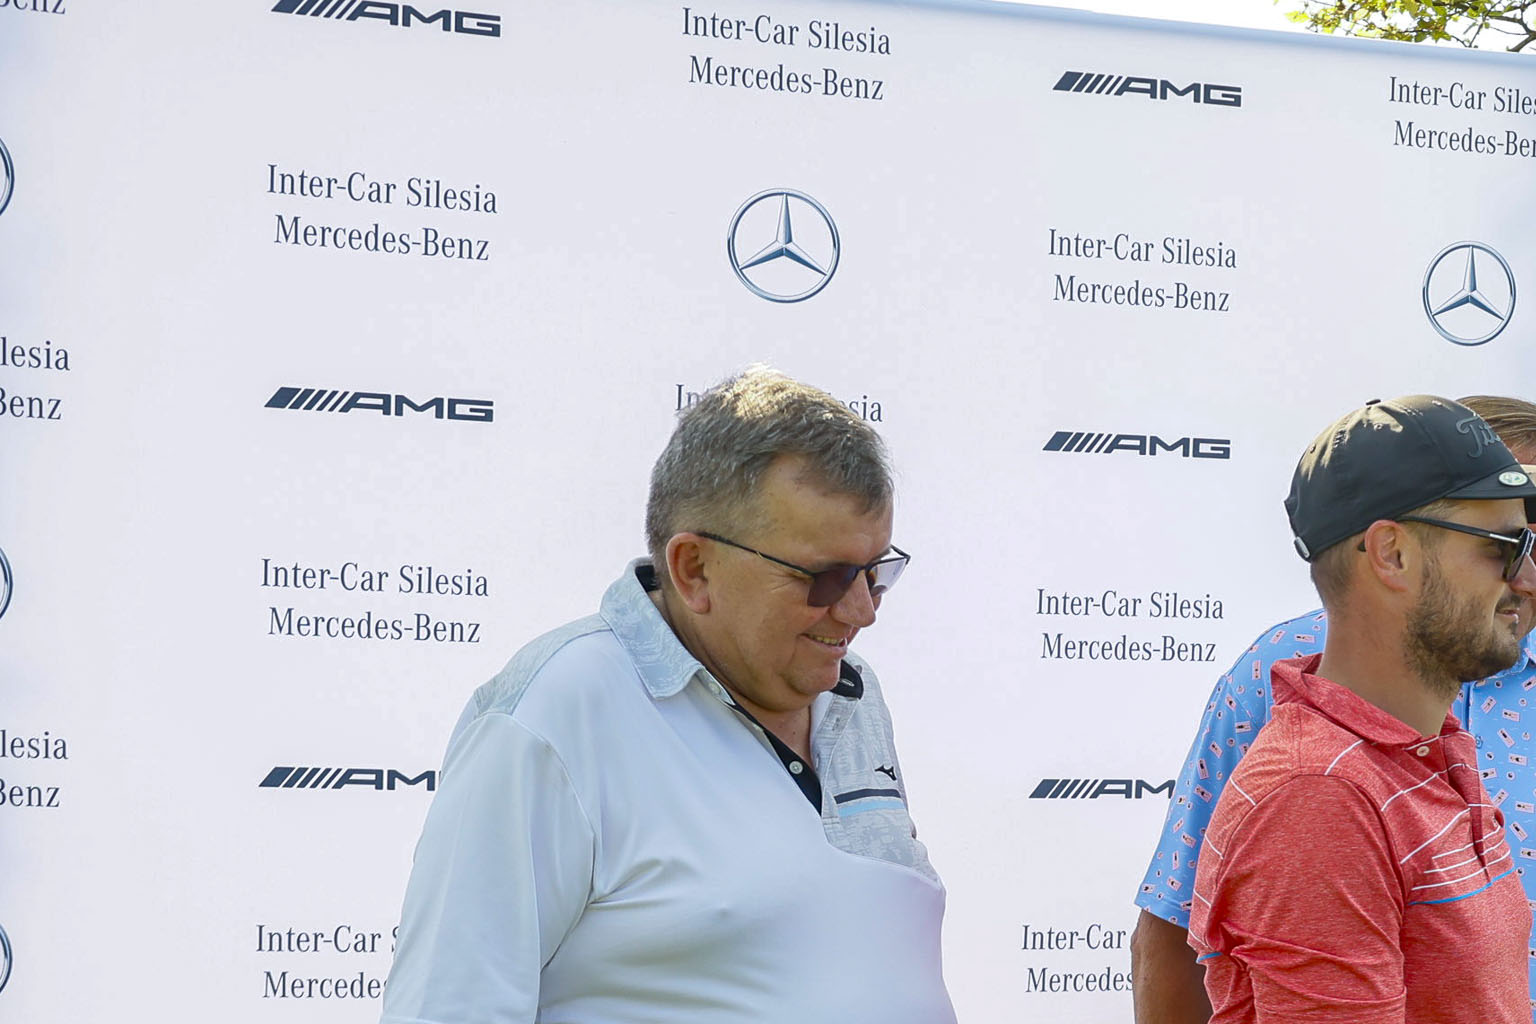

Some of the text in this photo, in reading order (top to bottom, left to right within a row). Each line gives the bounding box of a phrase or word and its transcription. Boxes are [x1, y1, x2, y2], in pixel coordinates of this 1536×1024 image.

[349, 0, 501, 38] AMG
[683, 8, 890, 55] Inter-Car Silesia
[689, 56, 883, 100] Mercedes-Benz
[1116, 76, 1241, 107] AMG
[1390, 77, 1486, 109] Inter-Car
[268, 164, 497, 213] Inter-Car Silesia
[274, 215, 488, 260] Mercedes-Benz
[1049, 229, 1236, 268] Inter-Car Silesia
[1054, 275, 1229, 311] Mercedes-Benz
[340, 391, 494, 422] AMG
[1103, 433, 1231, 459] AMG
[262, 559, 488, 596] Inter-Car Silesia
[1037, 589, 1223, 619] Inter-Car Silesia
[269, 607, 480, 642] Mercedes-Benz
[1041, 633, 1215, 661] Mercedes-Benz
[338, 767, 442, 791] AM
[1095, 779, 1176, 799] AM
[257, 925, 381, 952] Inter-Car
[1022, 924, 1126, 950] Inter-Car
[263, 970, 391, 999] Mercede
[1026, 965, 1134, 993] Mercedes
